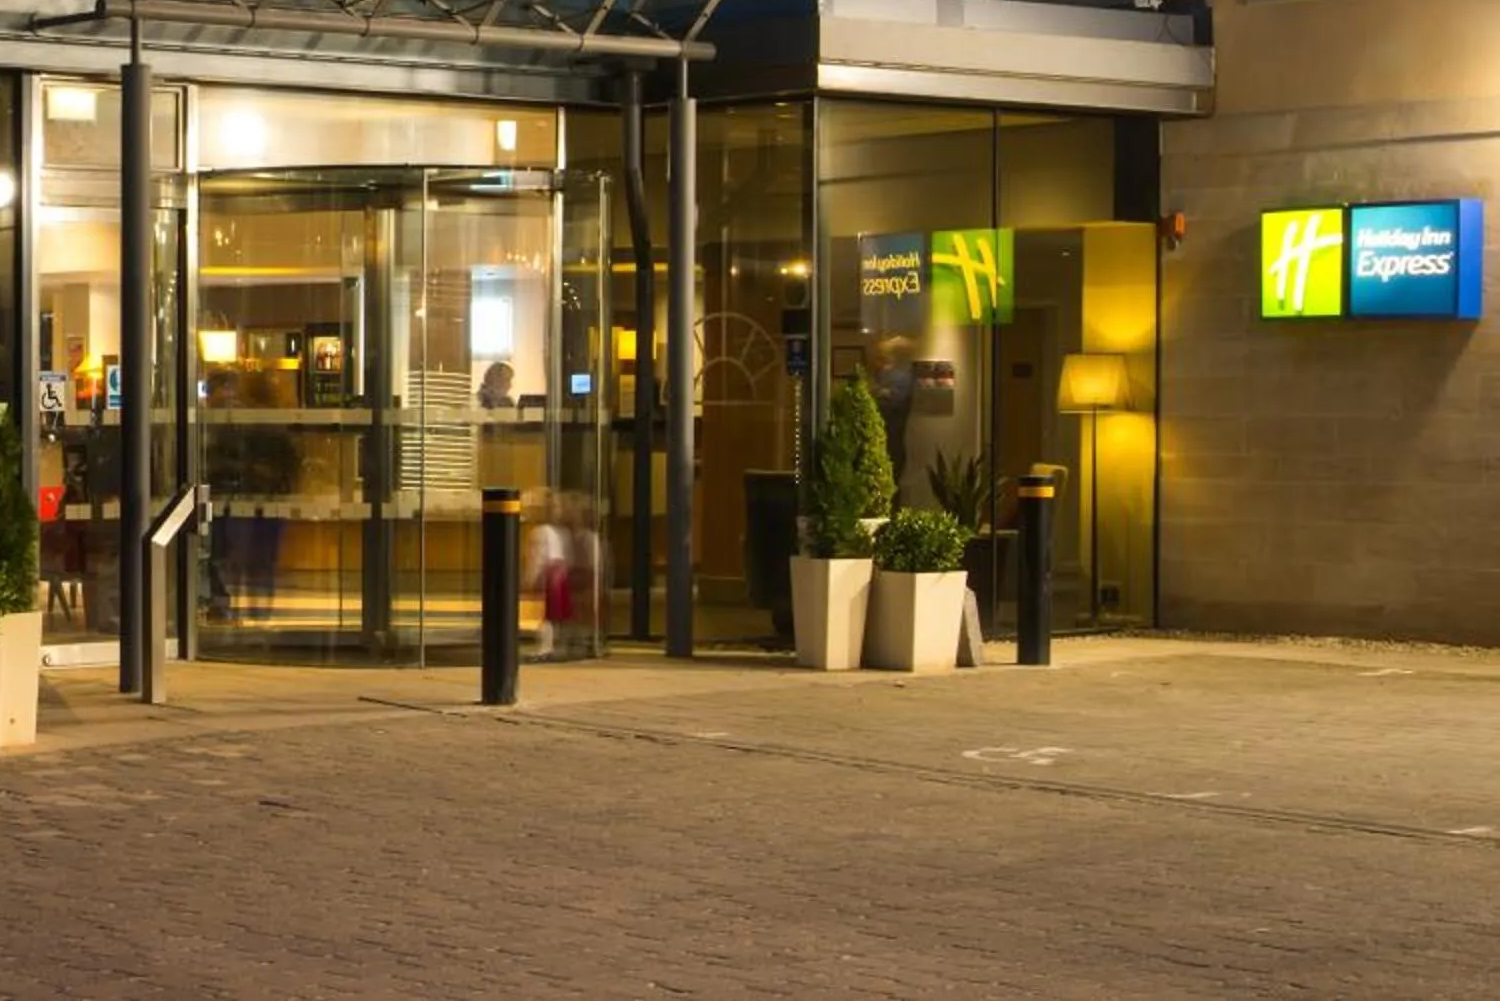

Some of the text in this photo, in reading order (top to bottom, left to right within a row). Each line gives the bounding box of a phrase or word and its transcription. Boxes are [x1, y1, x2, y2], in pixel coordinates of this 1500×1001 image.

[1358, 226, 1451, 250] Holiday Inn
[1358, 251, 1452, 283] Express
